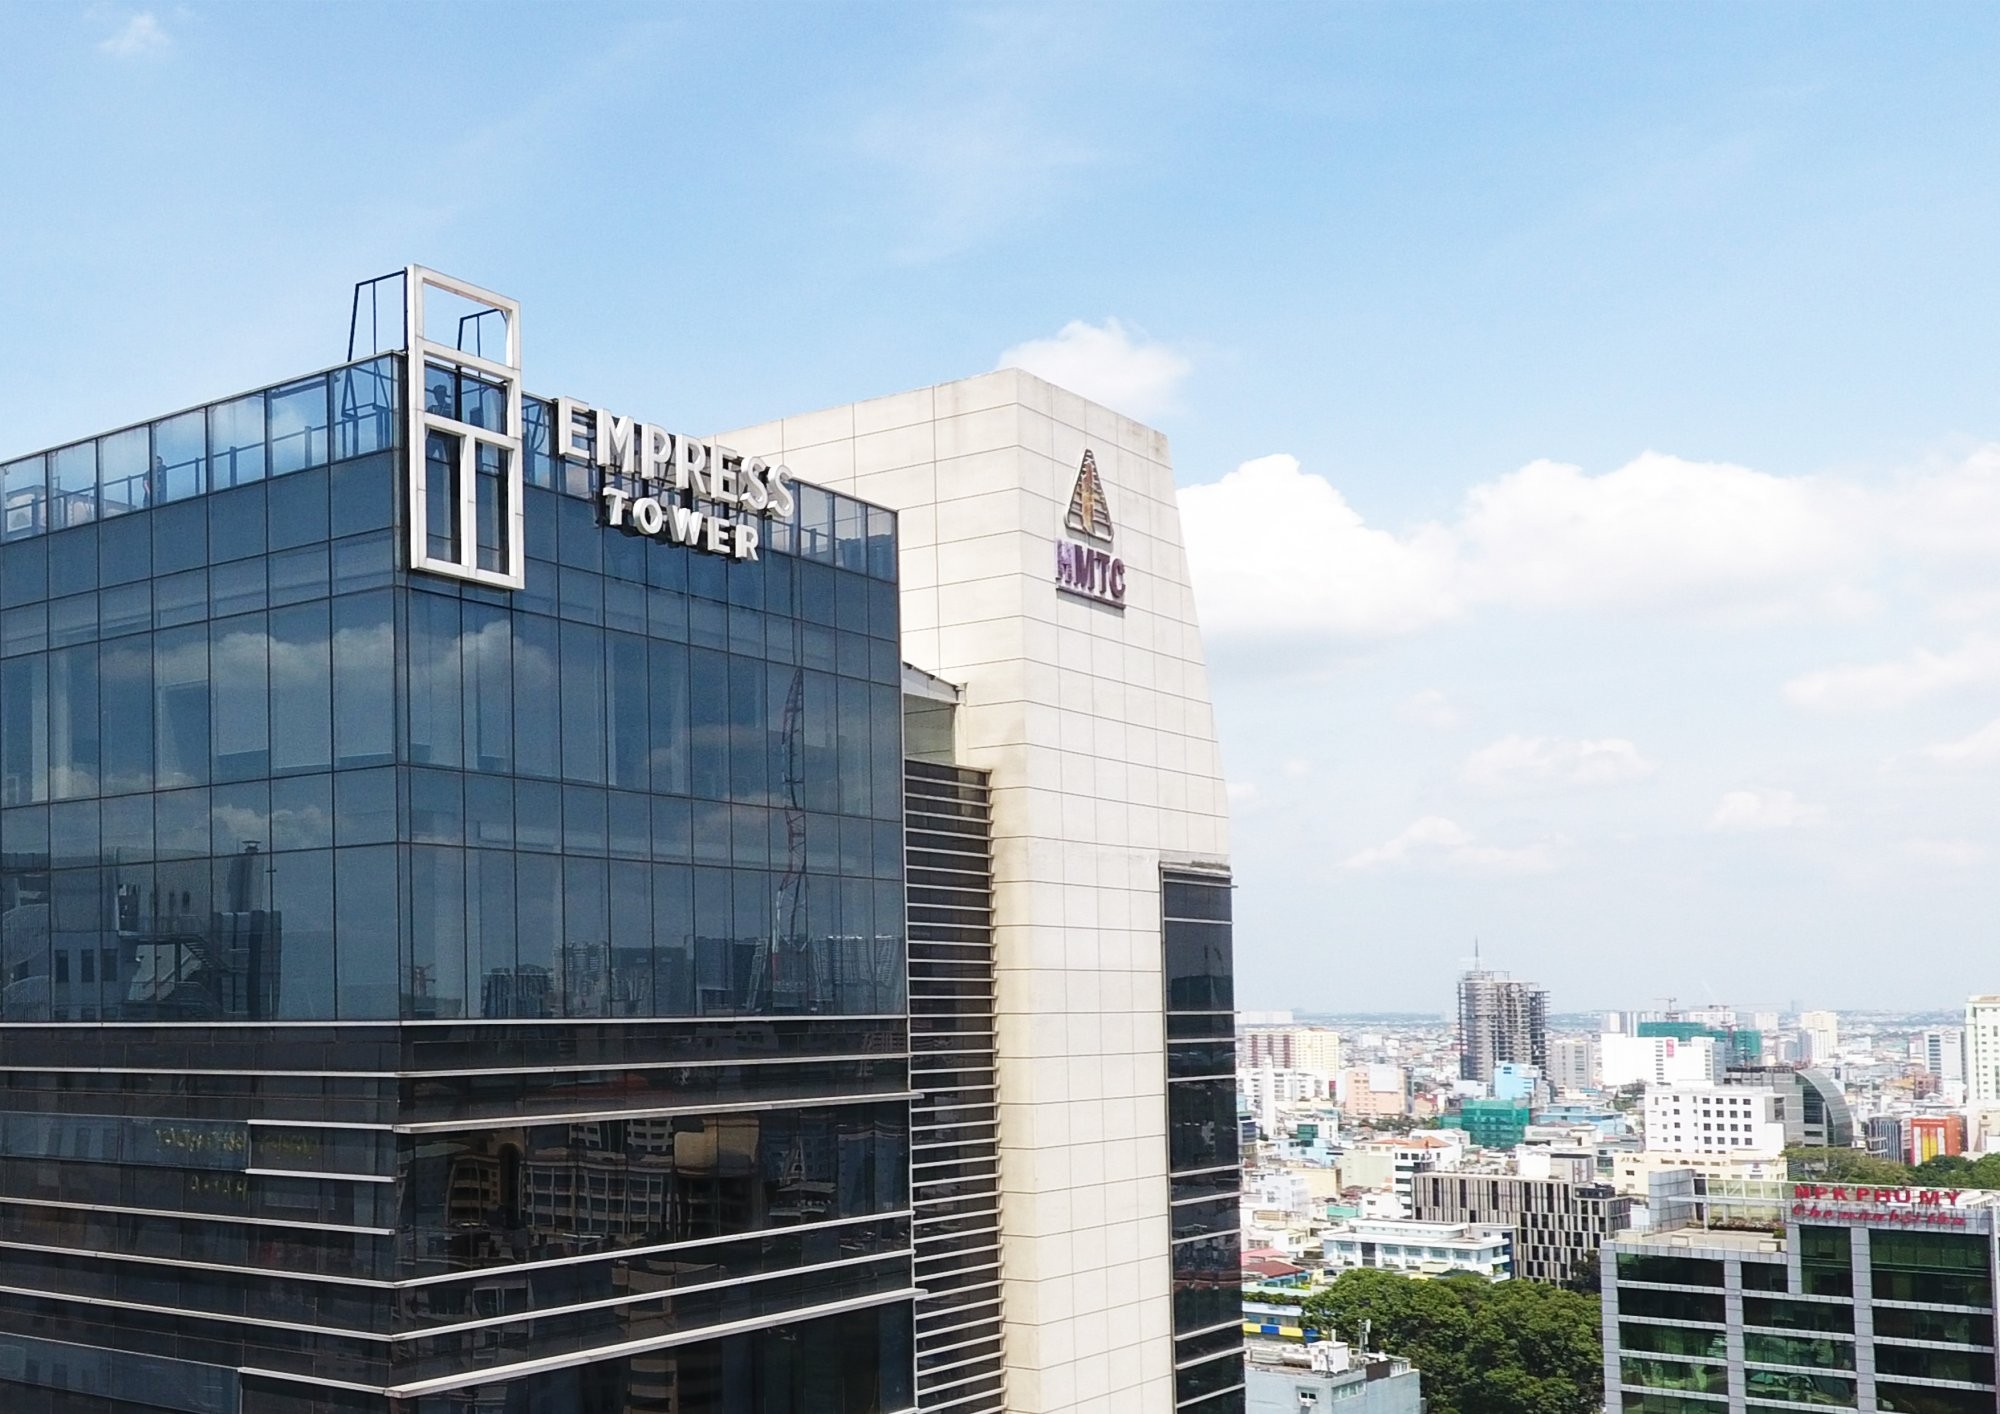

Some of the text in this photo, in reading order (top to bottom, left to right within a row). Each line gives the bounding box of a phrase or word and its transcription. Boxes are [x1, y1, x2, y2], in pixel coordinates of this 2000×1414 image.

[558, 396, 794, 518] EMPRESS
[602, 486, 759, 561] TOWER
[1055, 538, 1127, 598] HMTC
[1794, 1185, 1848, 1200] NPK
